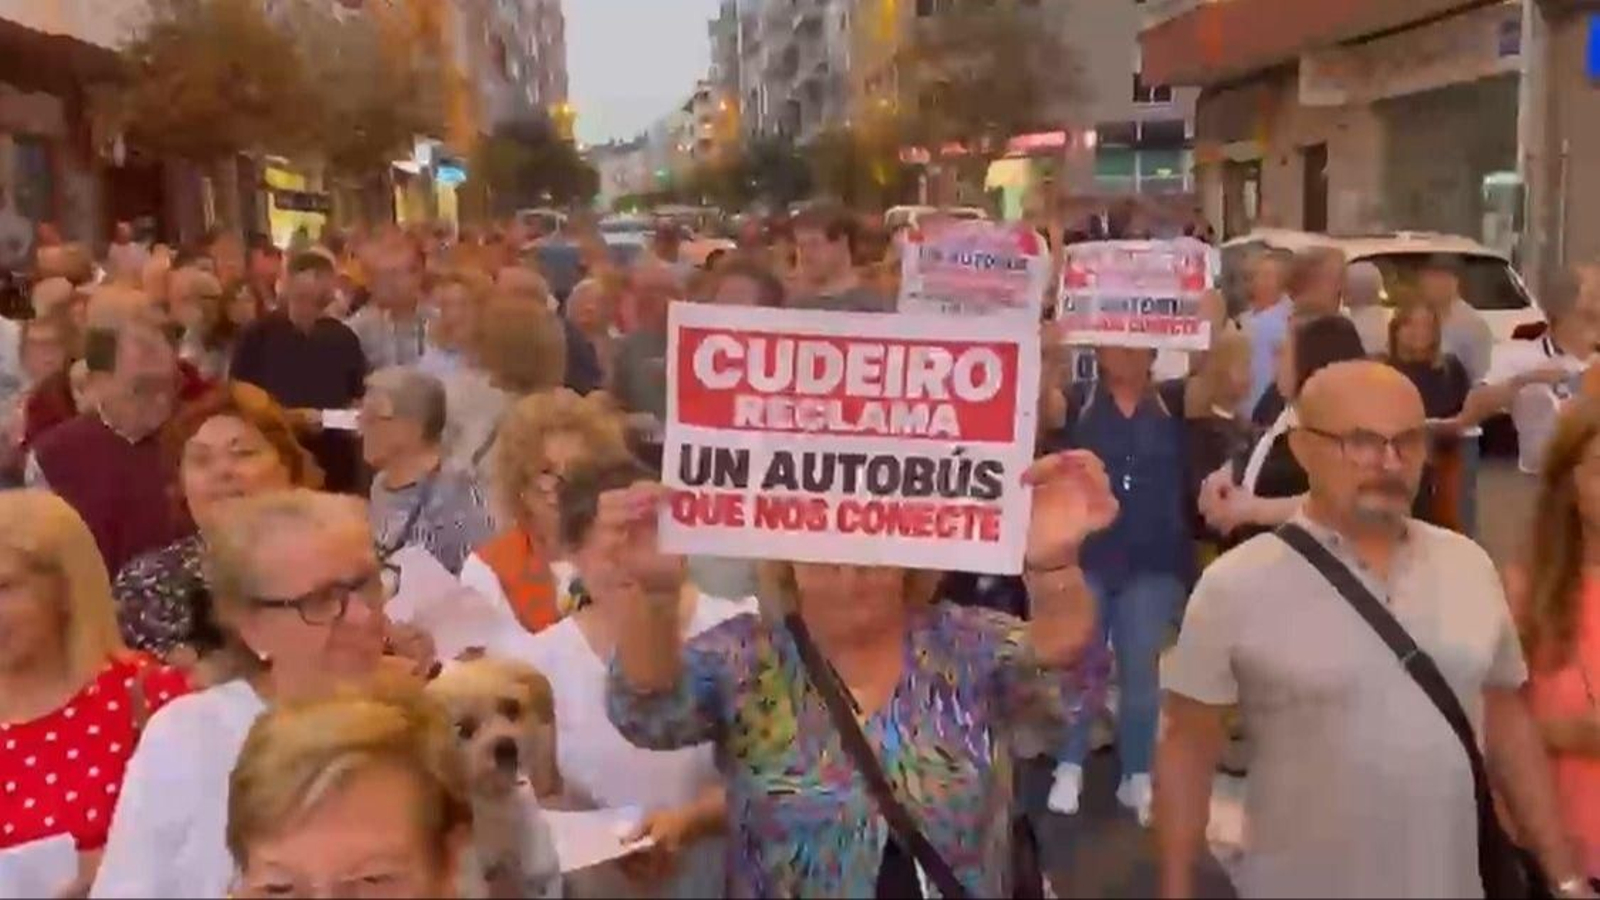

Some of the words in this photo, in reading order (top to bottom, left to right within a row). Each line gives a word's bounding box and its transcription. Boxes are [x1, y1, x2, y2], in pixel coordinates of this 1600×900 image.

[692, 334, 1003, 401] CUDEIRO
[734, 394, 960, 438] RECLAMA
[680, 444, 750, 489] UN
[761, 446, 1004, 500] AUTOBÚS
[671, 491, 745, 528] QUE
[754, 496, 830, 532] NOS
[837, 503, 1003, 542] CONECTE
